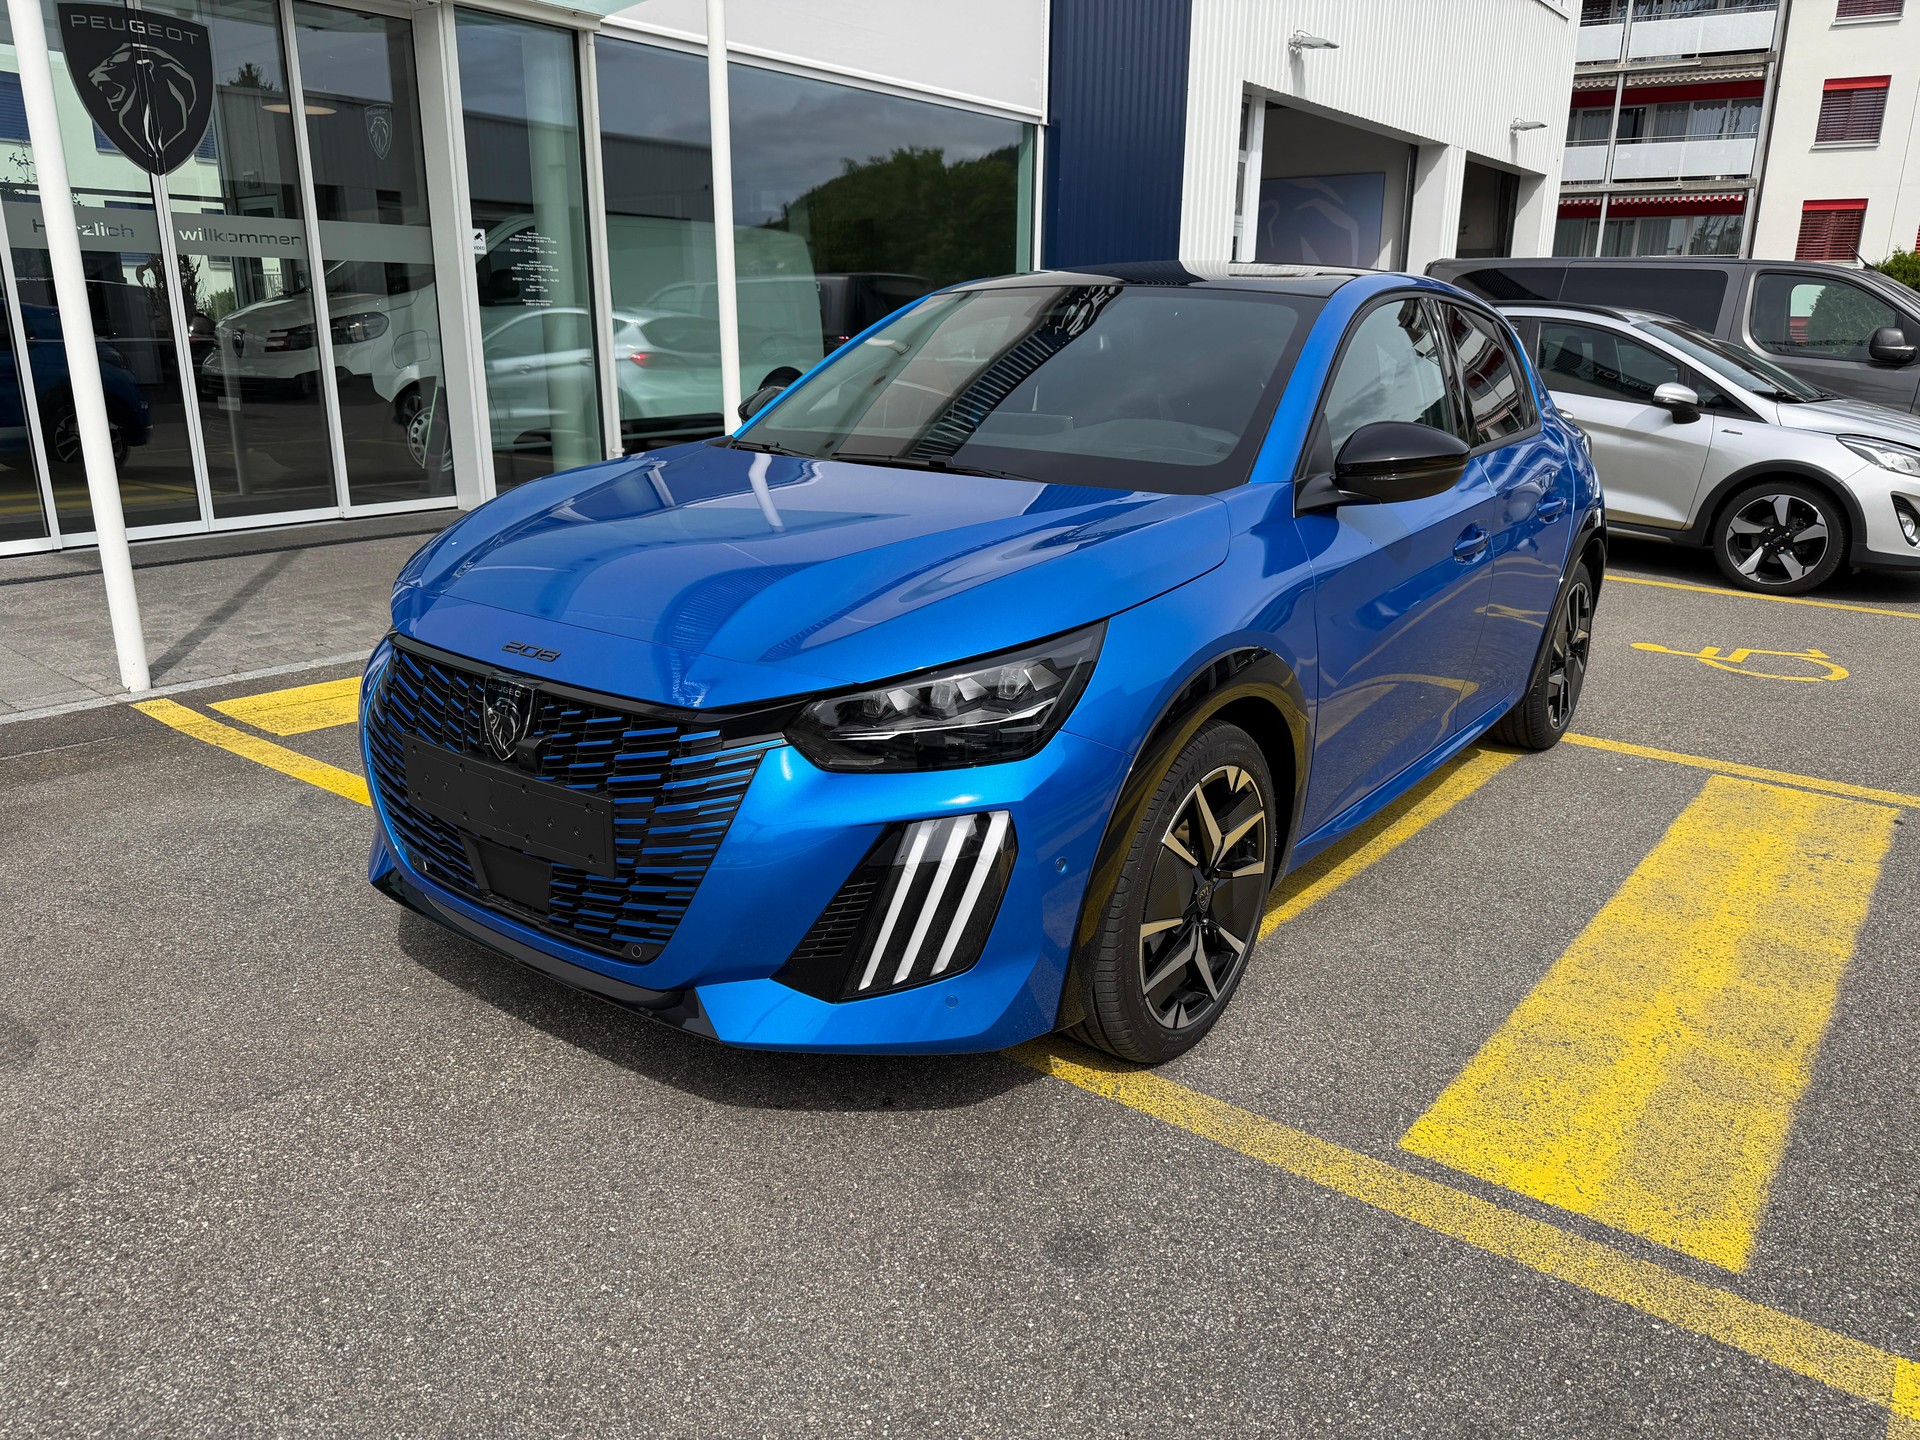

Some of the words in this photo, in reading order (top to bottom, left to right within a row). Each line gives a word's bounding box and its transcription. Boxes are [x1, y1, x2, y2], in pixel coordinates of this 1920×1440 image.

[70, 14, 199, 45] PEUGEOT
[31, 218, 135, 238] Hzlich
[178, 228, 302, 246] willkommen
[502, 641, 561, 662] 208
[488, 683, 527, 699] PEUGEOT
